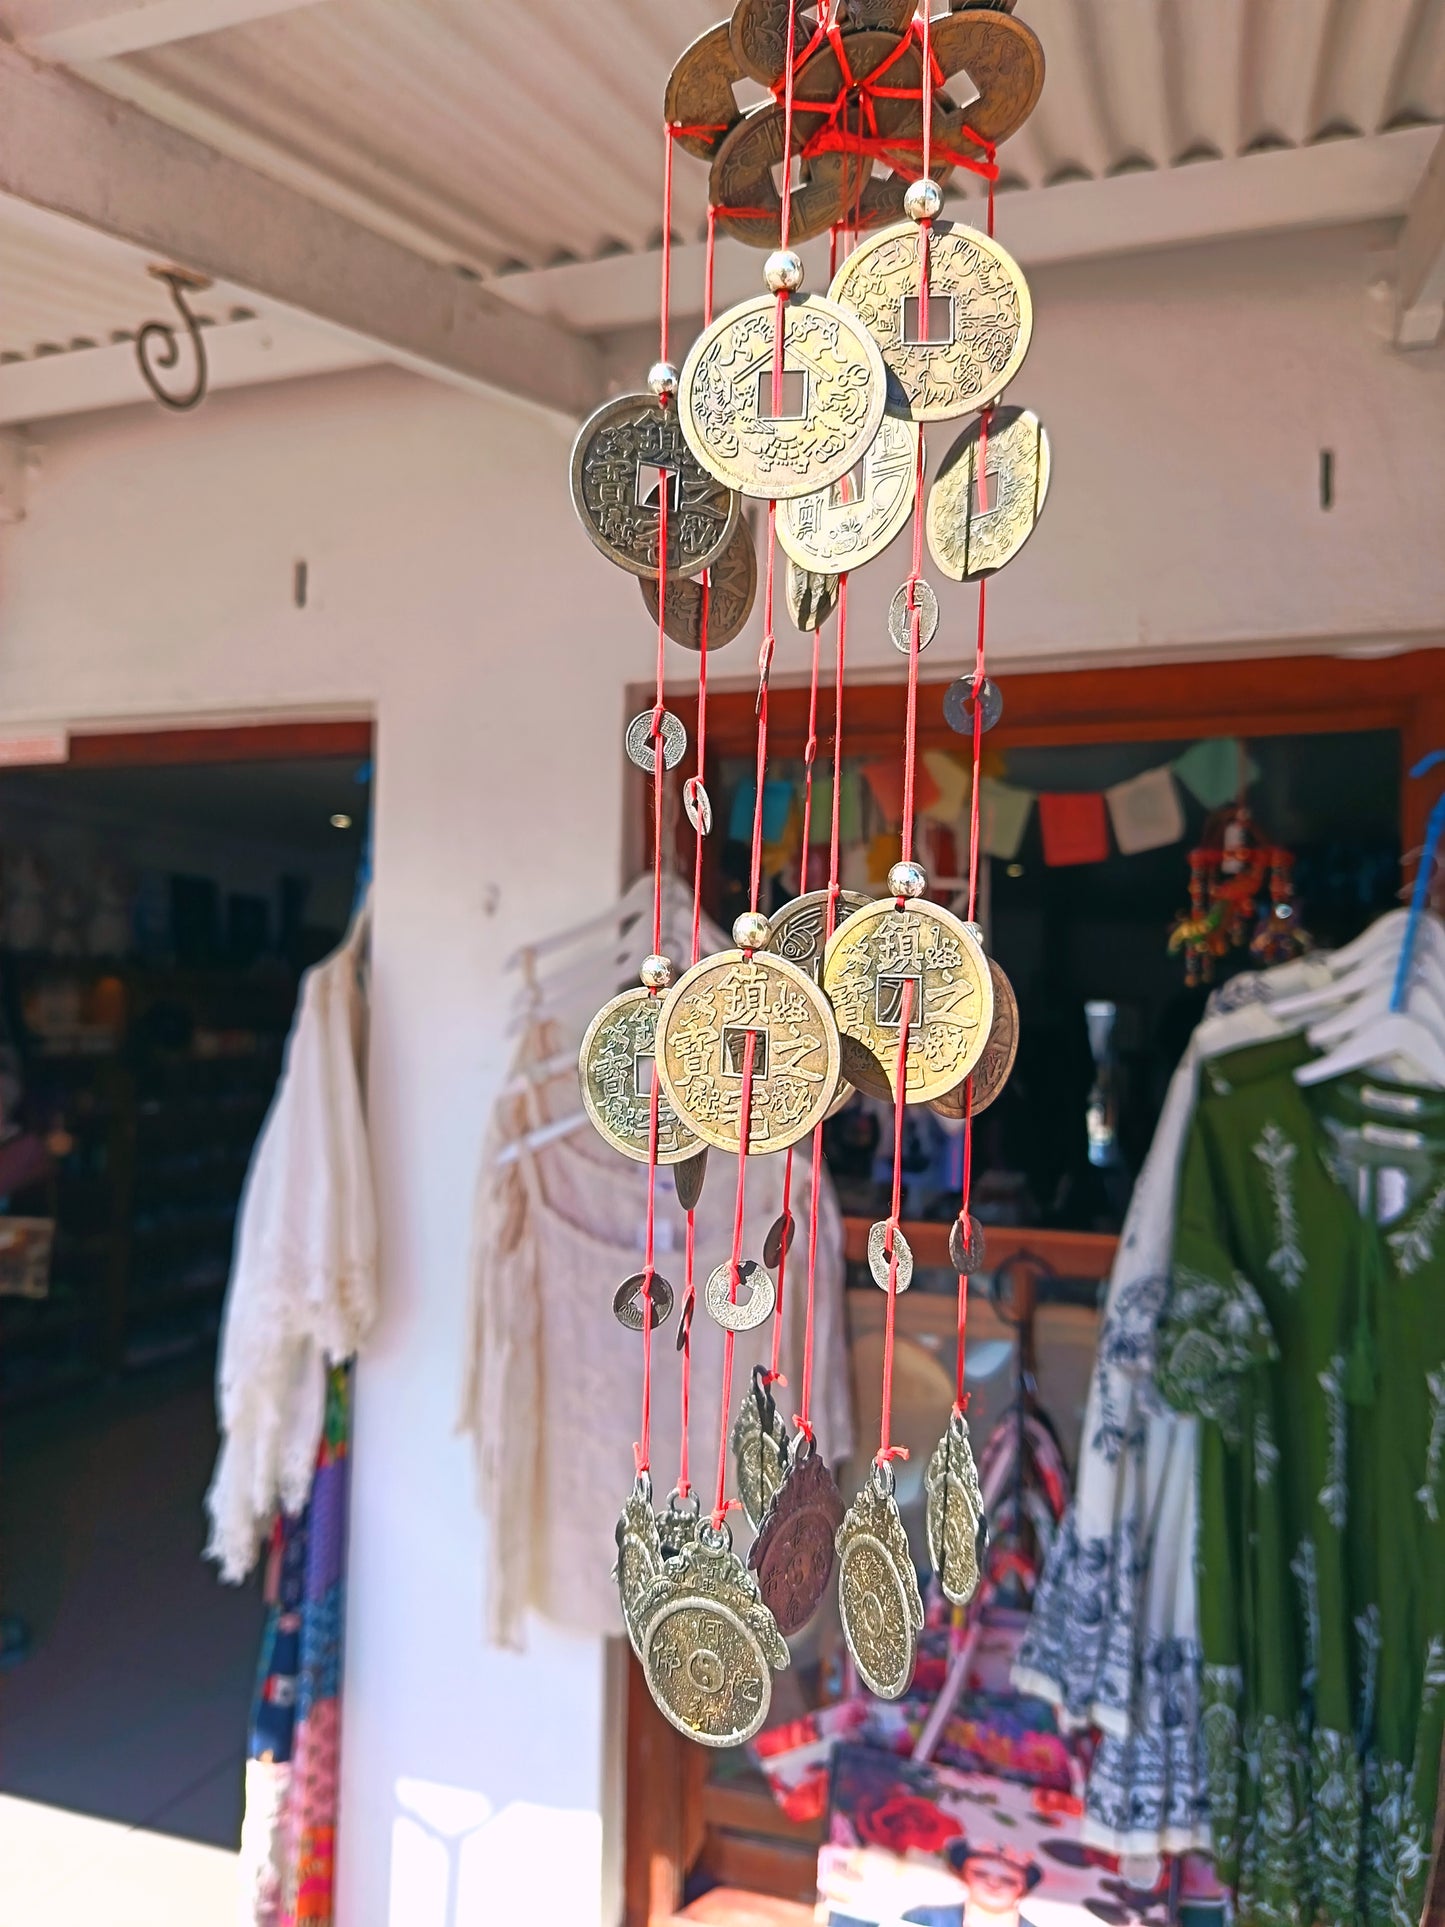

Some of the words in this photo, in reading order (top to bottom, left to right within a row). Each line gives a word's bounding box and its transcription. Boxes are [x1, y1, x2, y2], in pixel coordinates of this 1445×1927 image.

[716, 964, 772, 1025] 鎮
[770, 1023, 825, 1083] 之
[871, 911, 924, 973] 鎮
[923, 968, 979, 1029] 之
